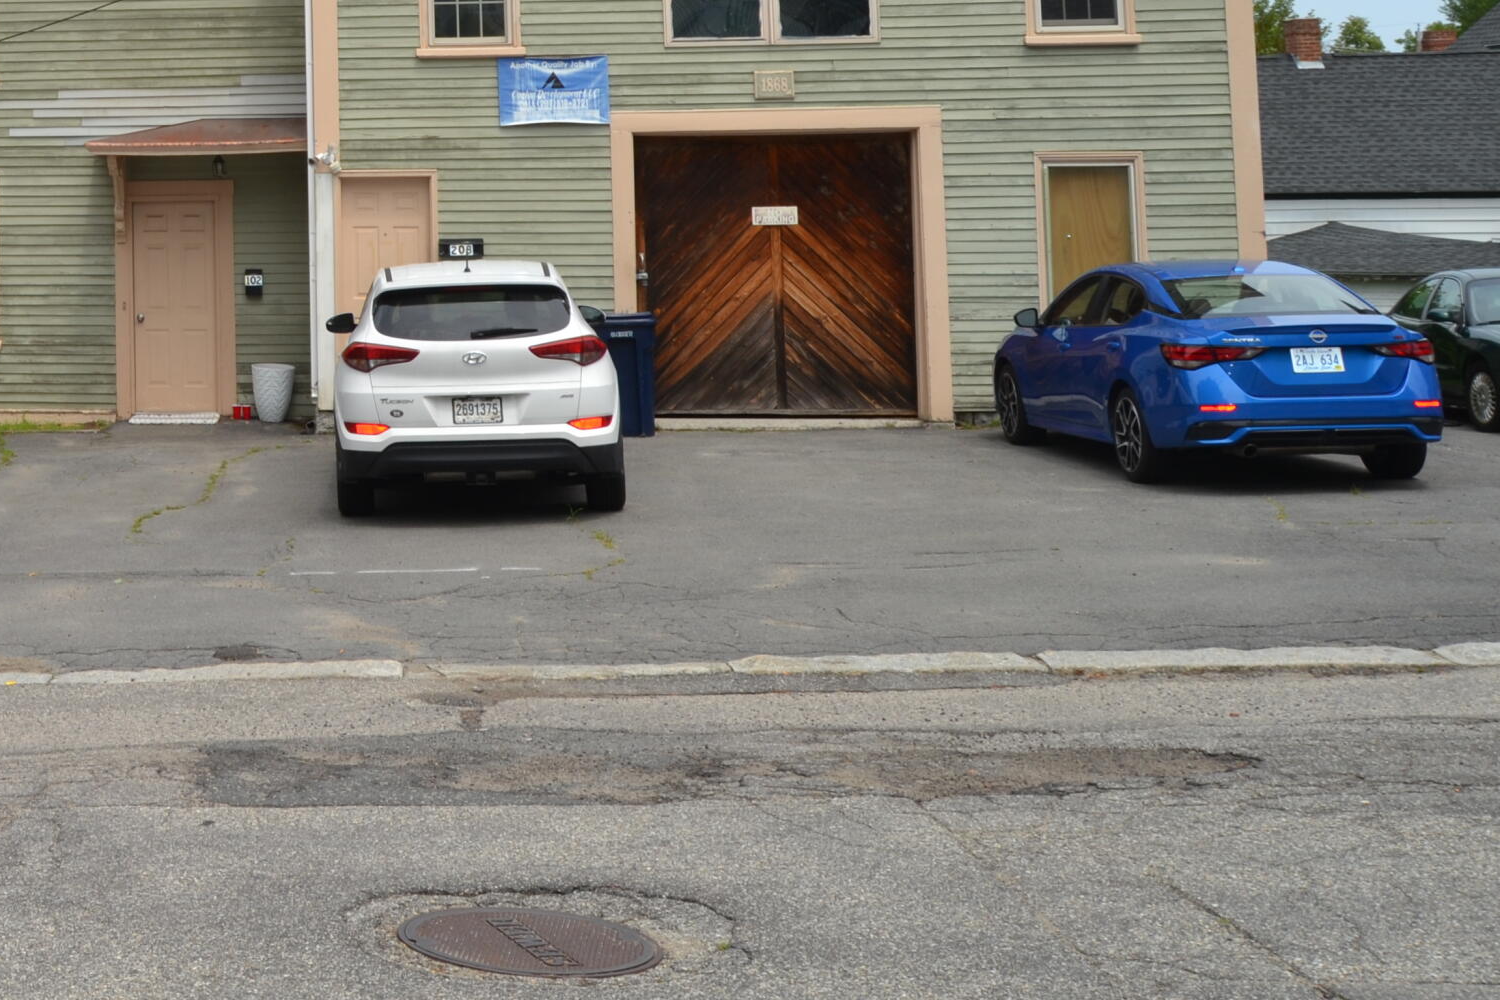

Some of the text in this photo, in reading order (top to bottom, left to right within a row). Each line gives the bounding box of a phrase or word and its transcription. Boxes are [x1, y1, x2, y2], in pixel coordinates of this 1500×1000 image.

[762, 76, 788, 92] 1868
[755, 215, 795, 225] PARKING
[246, 275, 262, 285] 102
[1320, 353, 1339, 365] 634
[456, 402, 498, 416] 2691375
